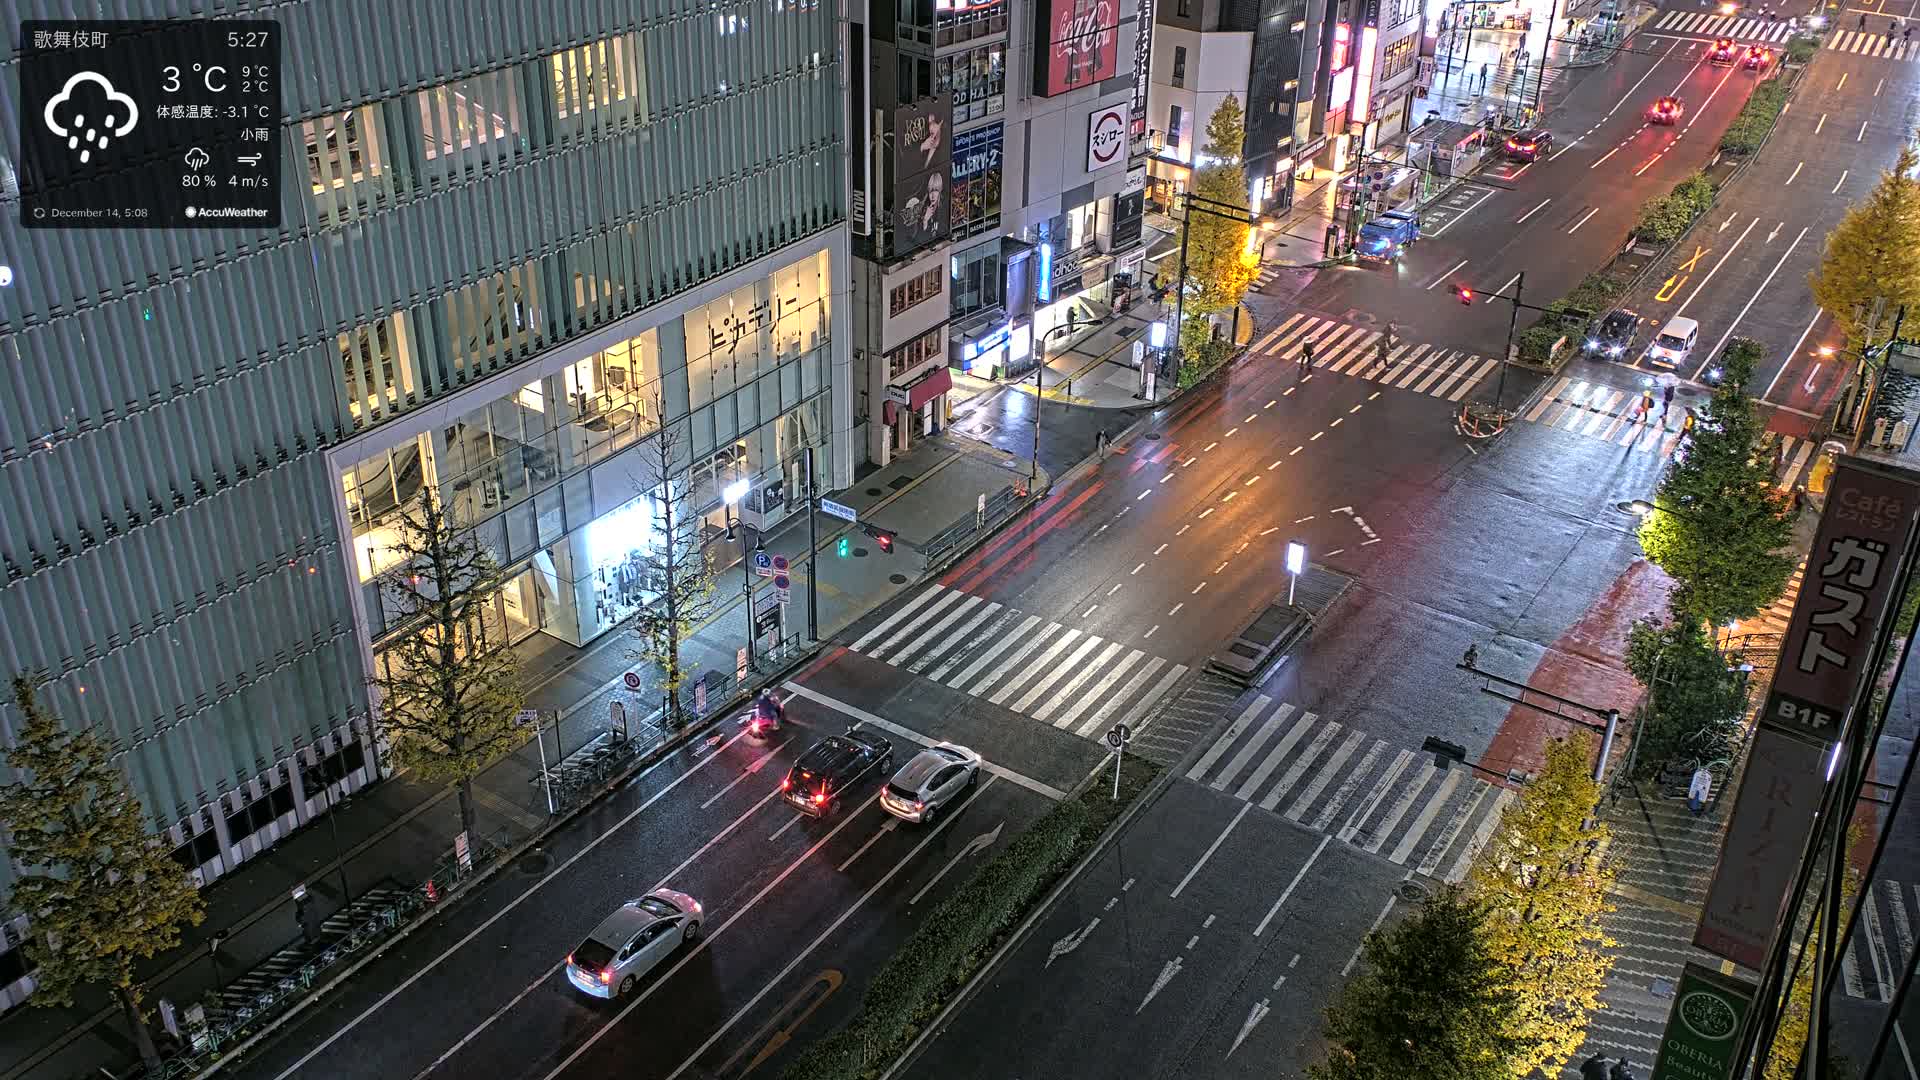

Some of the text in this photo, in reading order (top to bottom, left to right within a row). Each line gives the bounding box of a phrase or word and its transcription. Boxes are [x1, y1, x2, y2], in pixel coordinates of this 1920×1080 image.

[1056, 0, 1111, 57] Coca-Cola
[1093, 130, 1124, 147] スシロー
[853, 189, 865, 223] MUJI
[711, 298, 797, 354] ピカデリー
[1841, 487, 1903, 517] Café
[1799, 535, 1887, 674] ガスト
[1777, 699, 1832, 730] B1F
[1667, 1039, 1723, 1073] OBERIA
